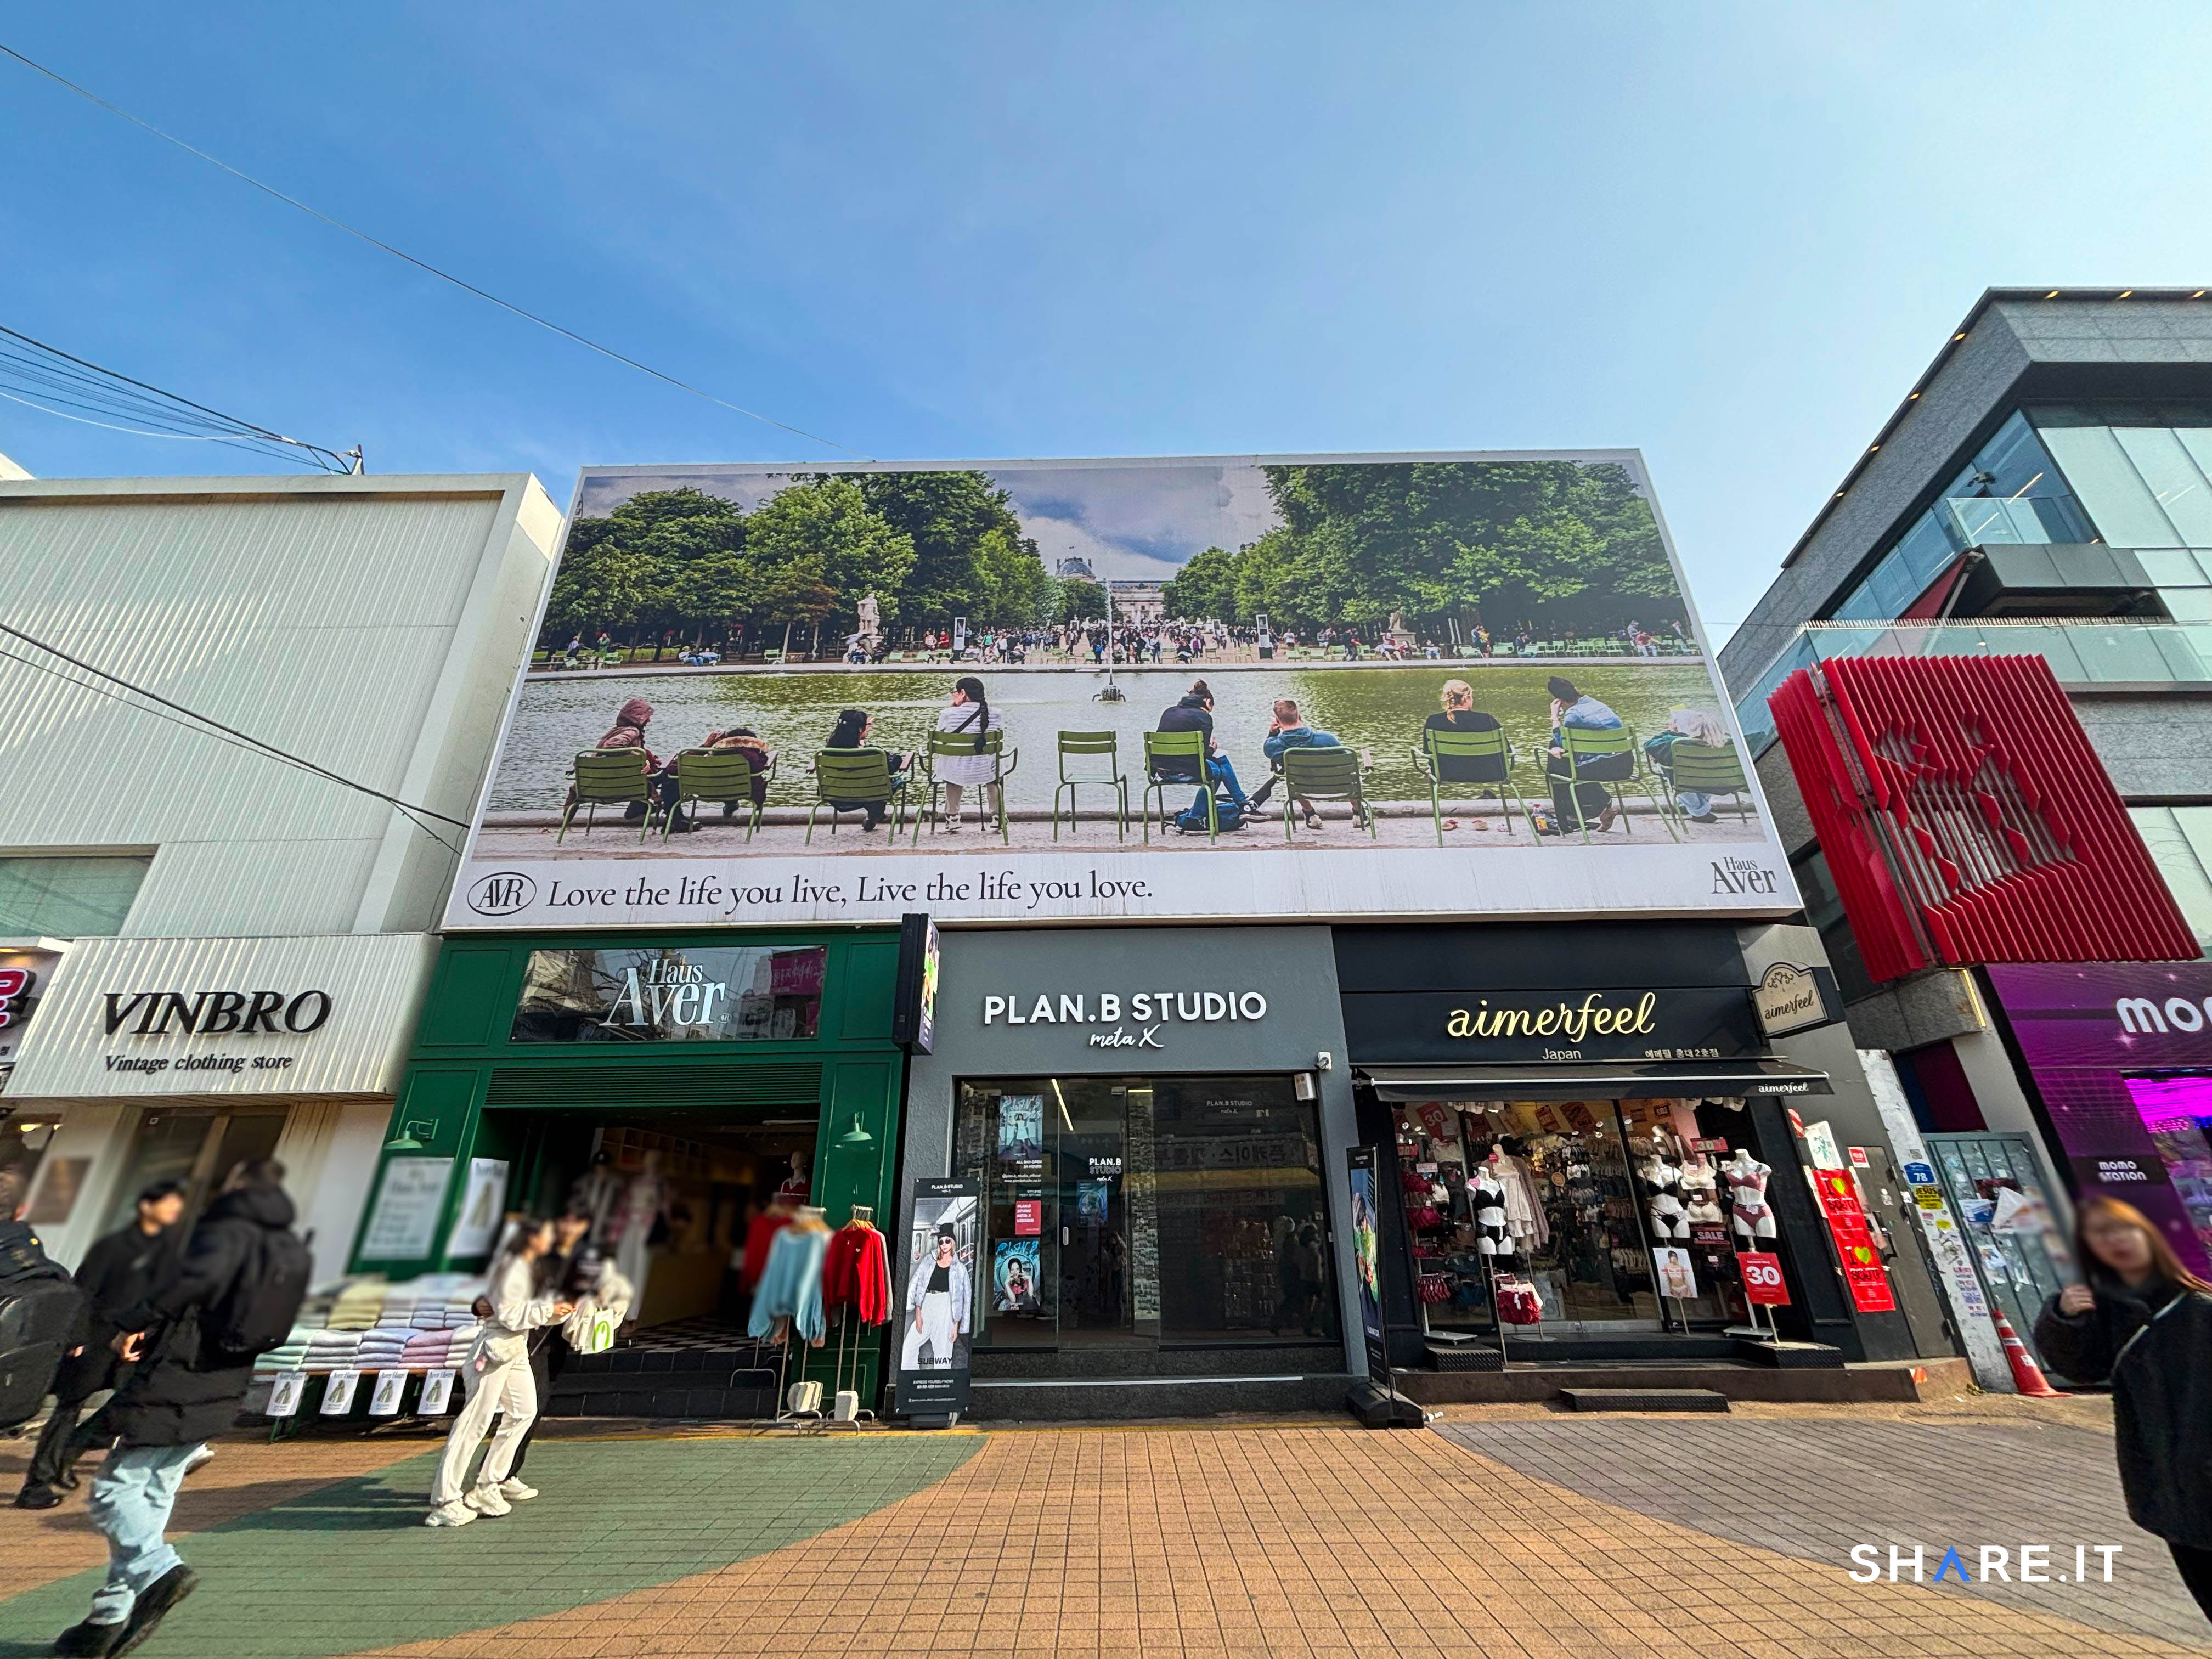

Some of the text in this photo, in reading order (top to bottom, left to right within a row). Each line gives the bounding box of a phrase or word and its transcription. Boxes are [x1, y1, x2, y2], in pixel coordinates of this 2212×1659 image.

[1723, 856, 1758, 871] Haus
[1711, 862, 1778, 894] Aver
[476, 879, 524, 908] AVR
[546, 870, 1153, 915] Love the life you live, Live the life you love.
[647, 958, 703, 984] Haus
[599, 967, 726, 1026] Aver
[985, 991, 1266, 1024] PLAN.B STUDIO
[1765, 990, 1814, 1019] aimerfeel
[103, 990, 332, 1035] VINBRO
[1447, 992, 1656, 1042] aimerfeel
[1090, 1024, 1164, 1048] meta X
[105, 1053, 292, 1074] Vintage clothing store
[1542, 1048, 1582, 1061] Japan
[1758, 1082, 1809, 1093] aimerfeel
[1425, 1110, 1443, 1126] 30
[1089, 1158, 1121, 1166] PLAN.B
[1914, 1172, 1928, 1182] 78
[1697, 1232, 1724, 1240] SALE
[1746, 1266, 1780, 1284] 30
[917, 1357, 952, 1365] SUBWAY
